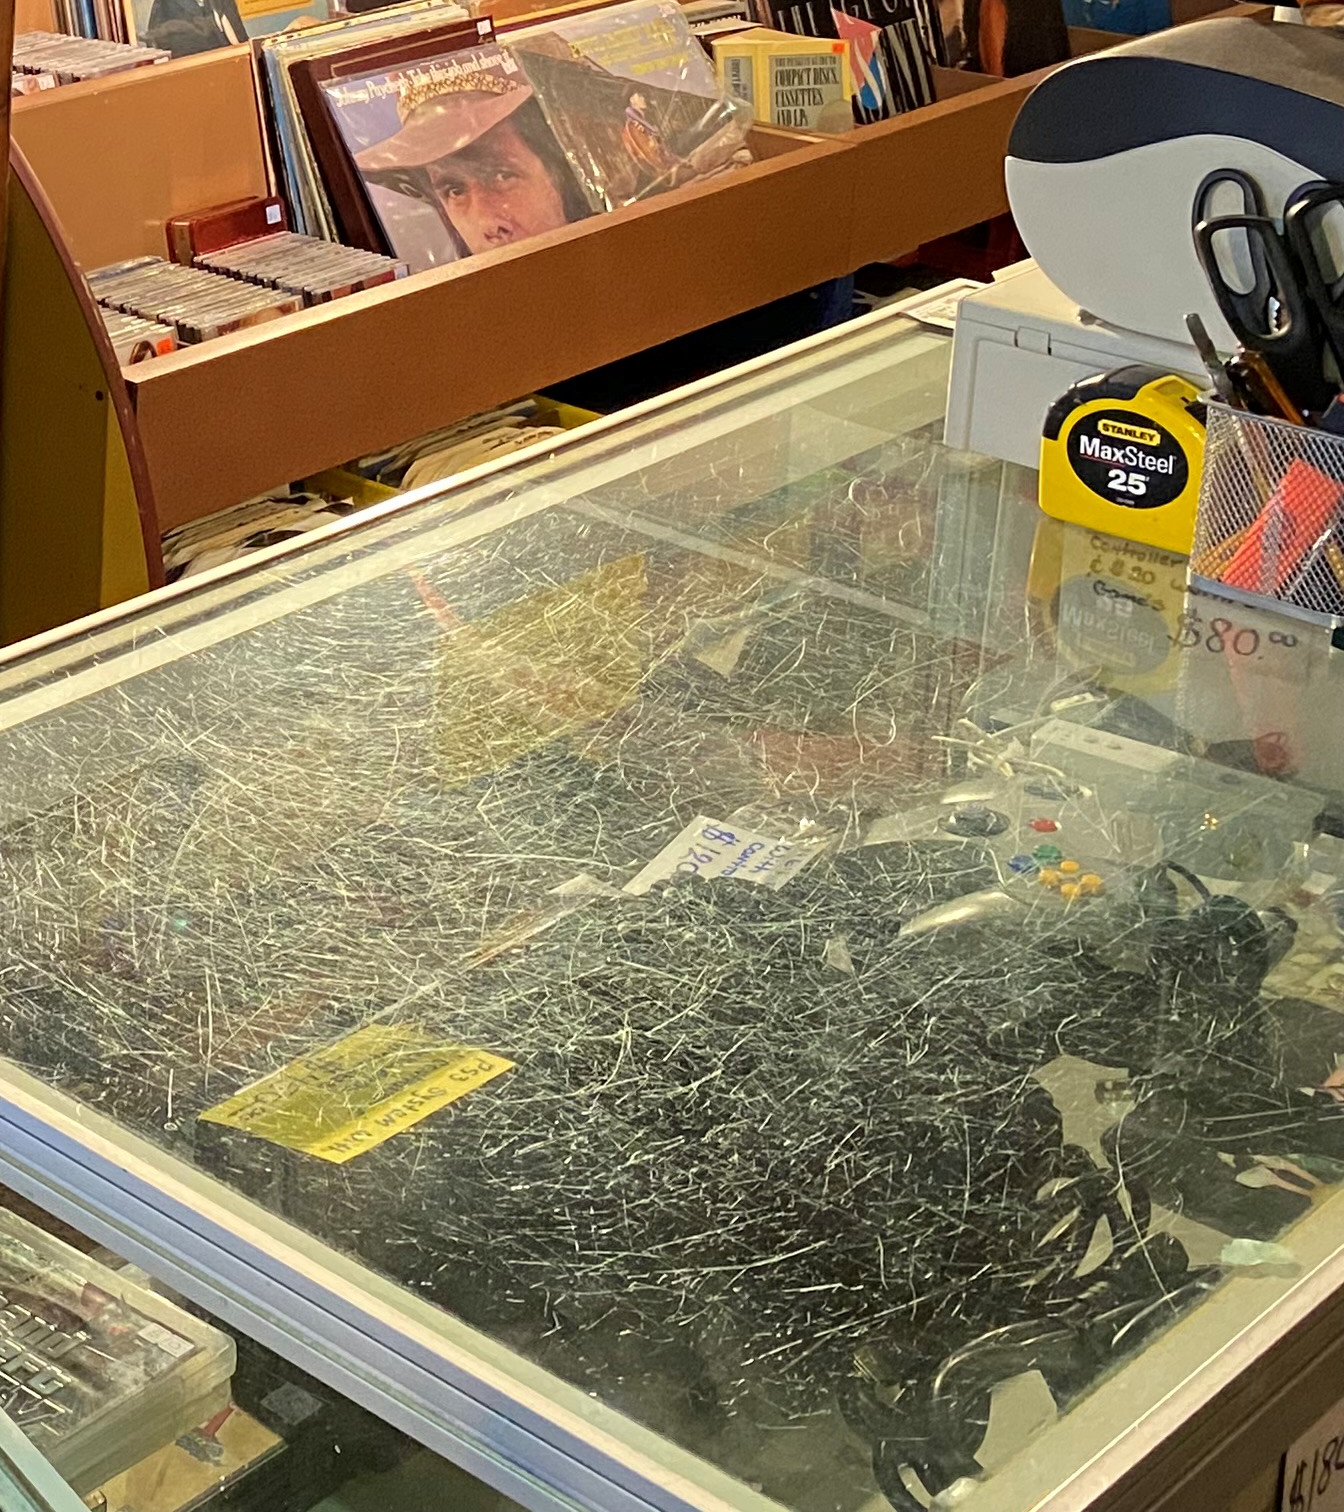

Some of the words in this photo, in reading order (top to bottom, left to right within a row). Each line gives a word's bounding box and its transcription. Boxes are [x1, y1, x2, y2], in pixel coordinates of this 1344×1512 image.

[774, 67, 812, 87] COMPACT
[774, 87, 824, 108] CASSETTES
[1100, 422, 1159, 444] STANLEY
[1079, 435, 1176, 475] MaxSteel
[1090, 535, 1184, 568] Controller
[374, 1086, 448, 1128] System
[1289, 1435, 1344, 1512] $18
